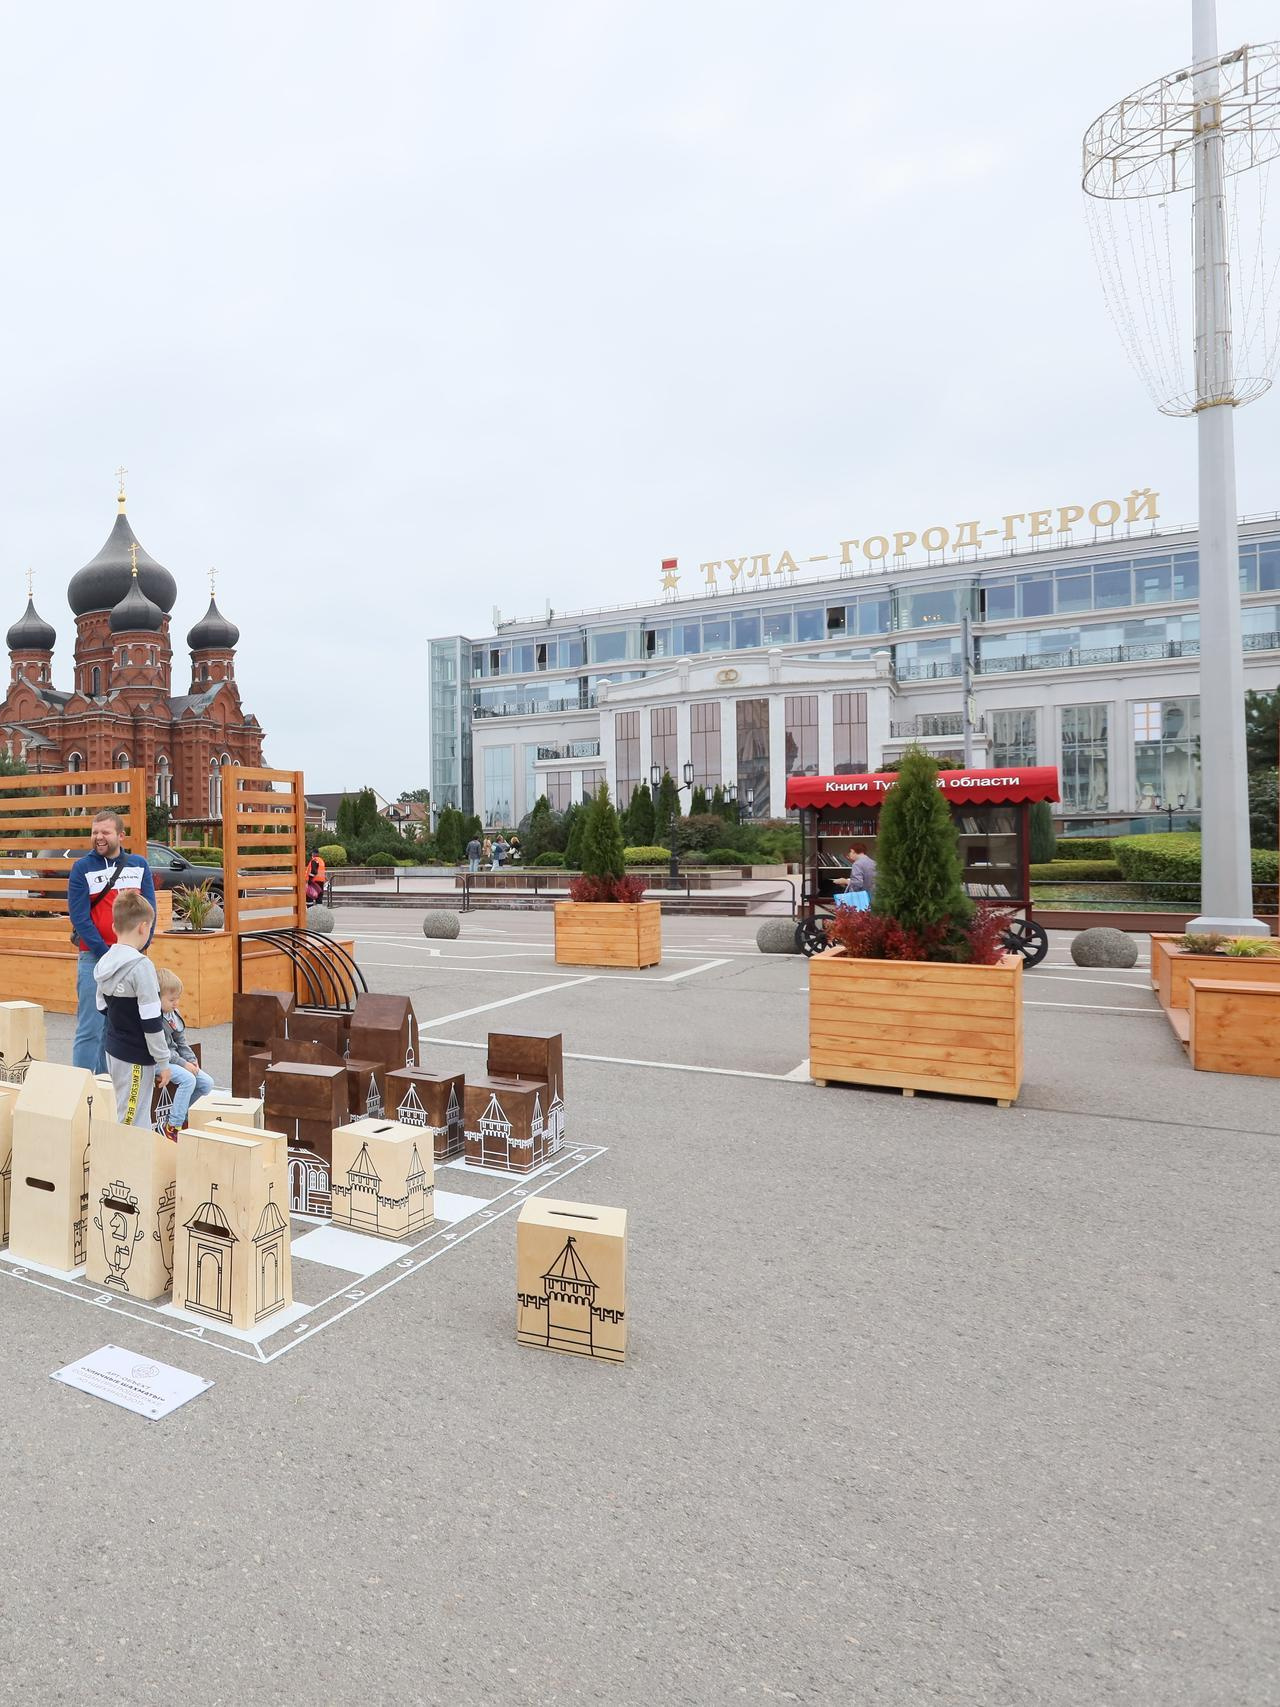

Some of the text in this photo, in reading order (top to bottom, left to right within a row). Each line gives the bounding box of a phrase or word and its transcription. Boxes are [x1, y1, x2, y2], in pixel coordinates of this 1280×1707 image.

[700, 551, 800, 584] ТУЛА
[838, 488, 1160, 564] ГОРОД-ГЕРОЙ
[825, 782, 869, 792] Книги
[950, 776, 1021, 788] области
[11, 1267, 28, 1275] C
[93, 1294, 113, 1304] B
[183, 1326, 206, 1337] A
[293, 1323, 310, 1334] 1
[344, 1289, 365, 1300] 2
[396, 1258, 415, 1268] 3
[440, 1232, 458, 1241] 4
[477, 1209, 497, 1218] 5
